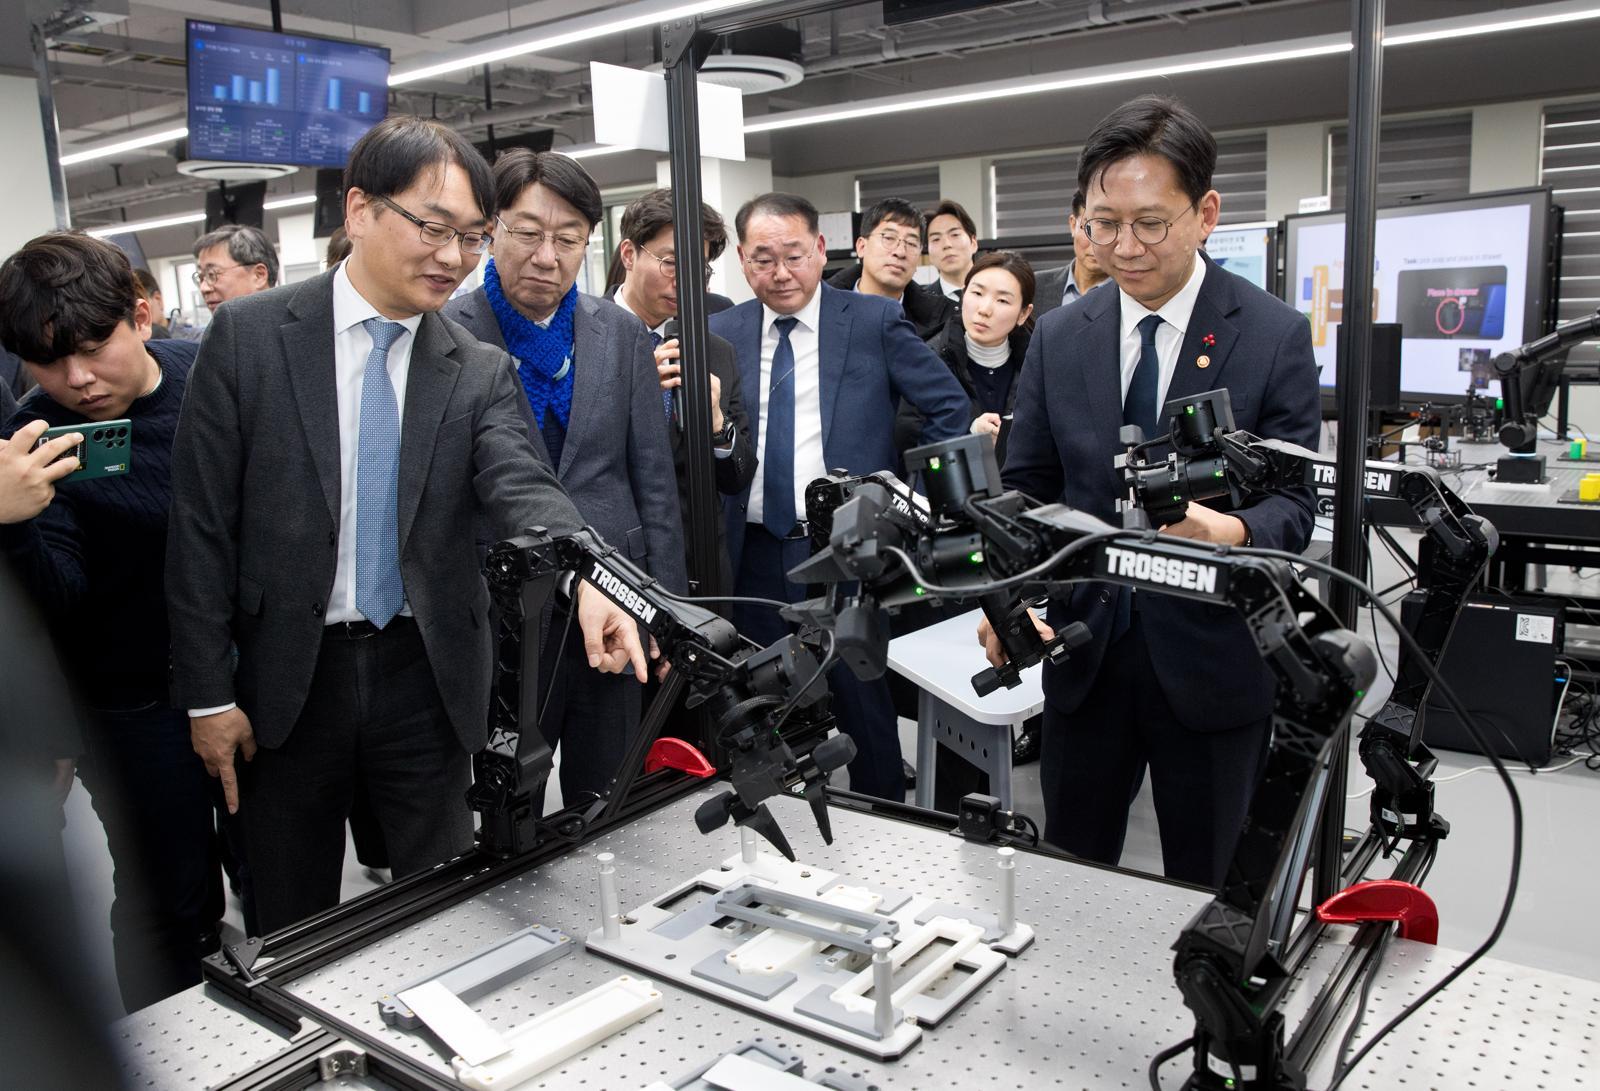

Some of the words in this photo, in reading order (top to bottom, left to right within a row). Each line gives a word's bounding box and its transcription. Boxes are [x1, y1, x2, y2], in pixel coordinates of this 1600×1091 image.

[1312, 463, 1392, 492] TREN
[590, 561, 658, 625] TROSSEN
[1105, 546, 1218, 594] TROSSEN
